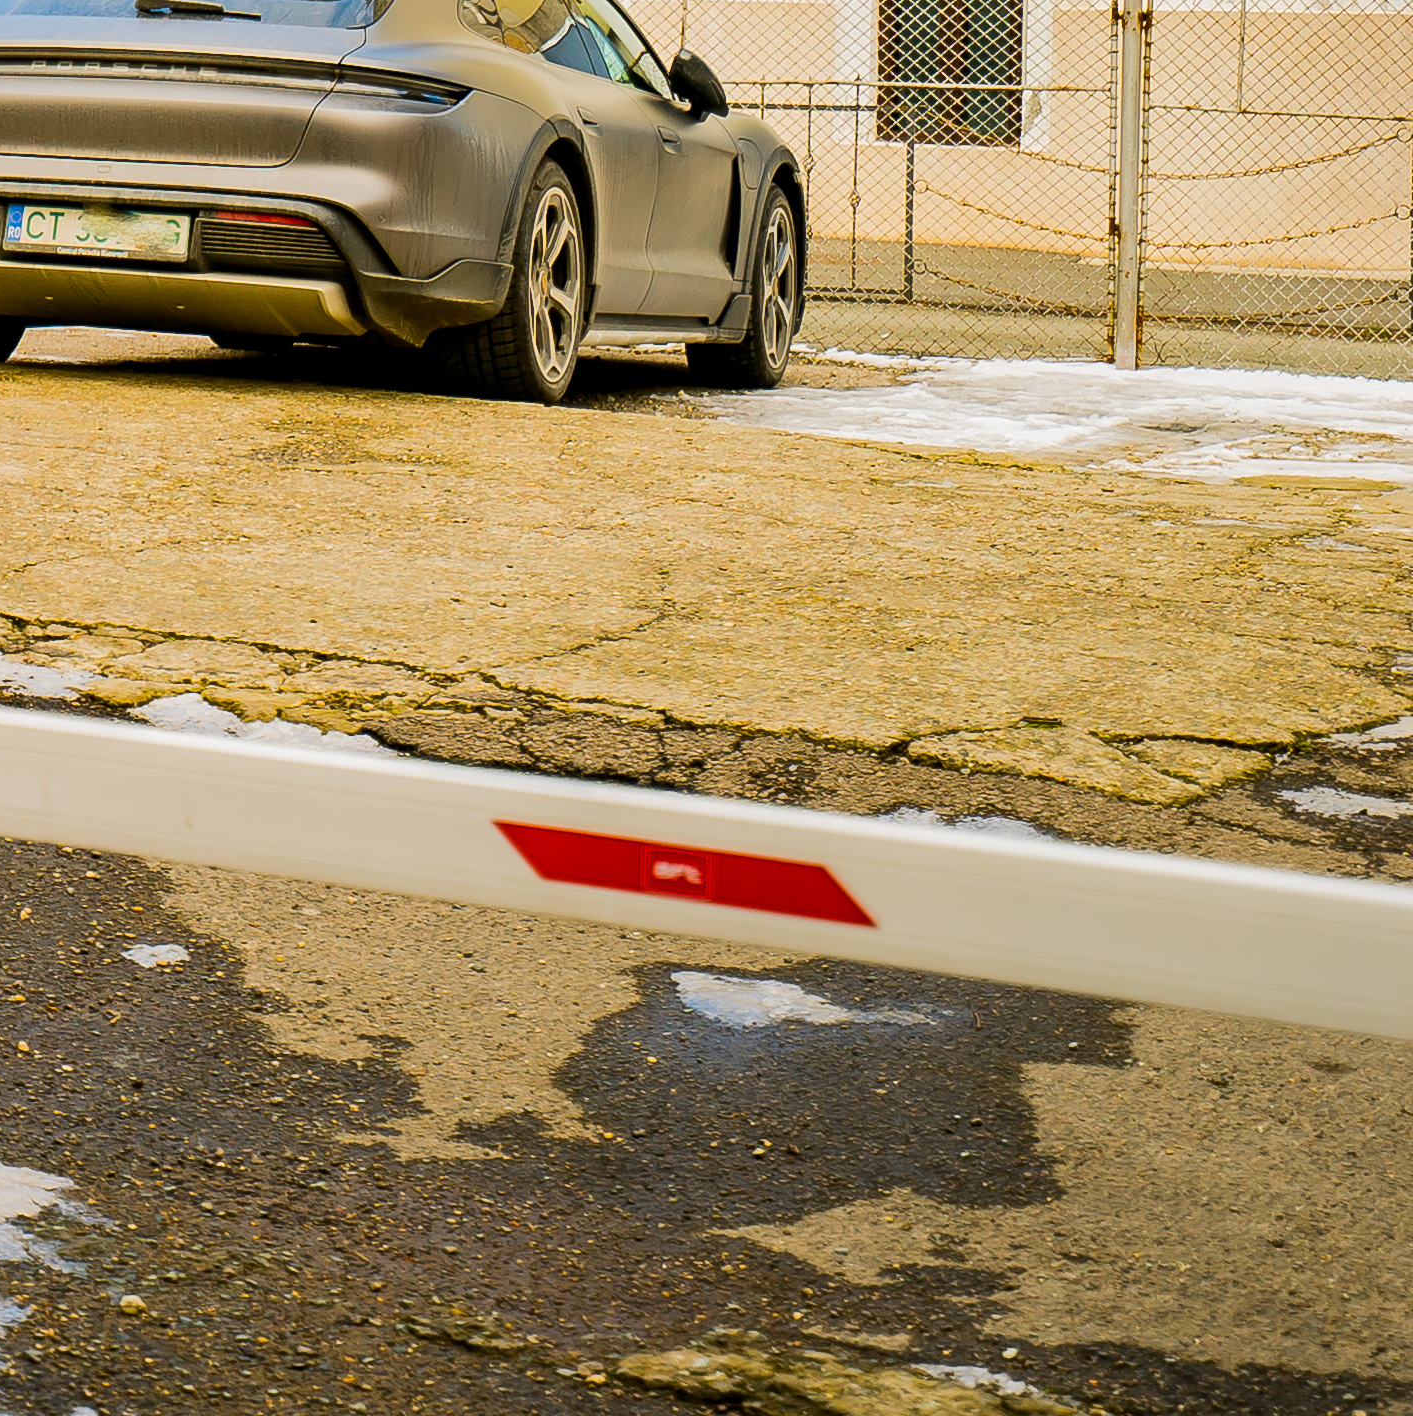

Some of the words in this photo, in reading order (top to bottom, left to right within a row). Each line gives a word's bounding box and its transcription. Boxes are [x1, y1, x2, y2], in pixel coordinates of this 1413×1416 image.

[30, 60, 219, 77] PORSCHE
[7, 225, 22, 240] RO
[25, 210, 66, 241] CT
